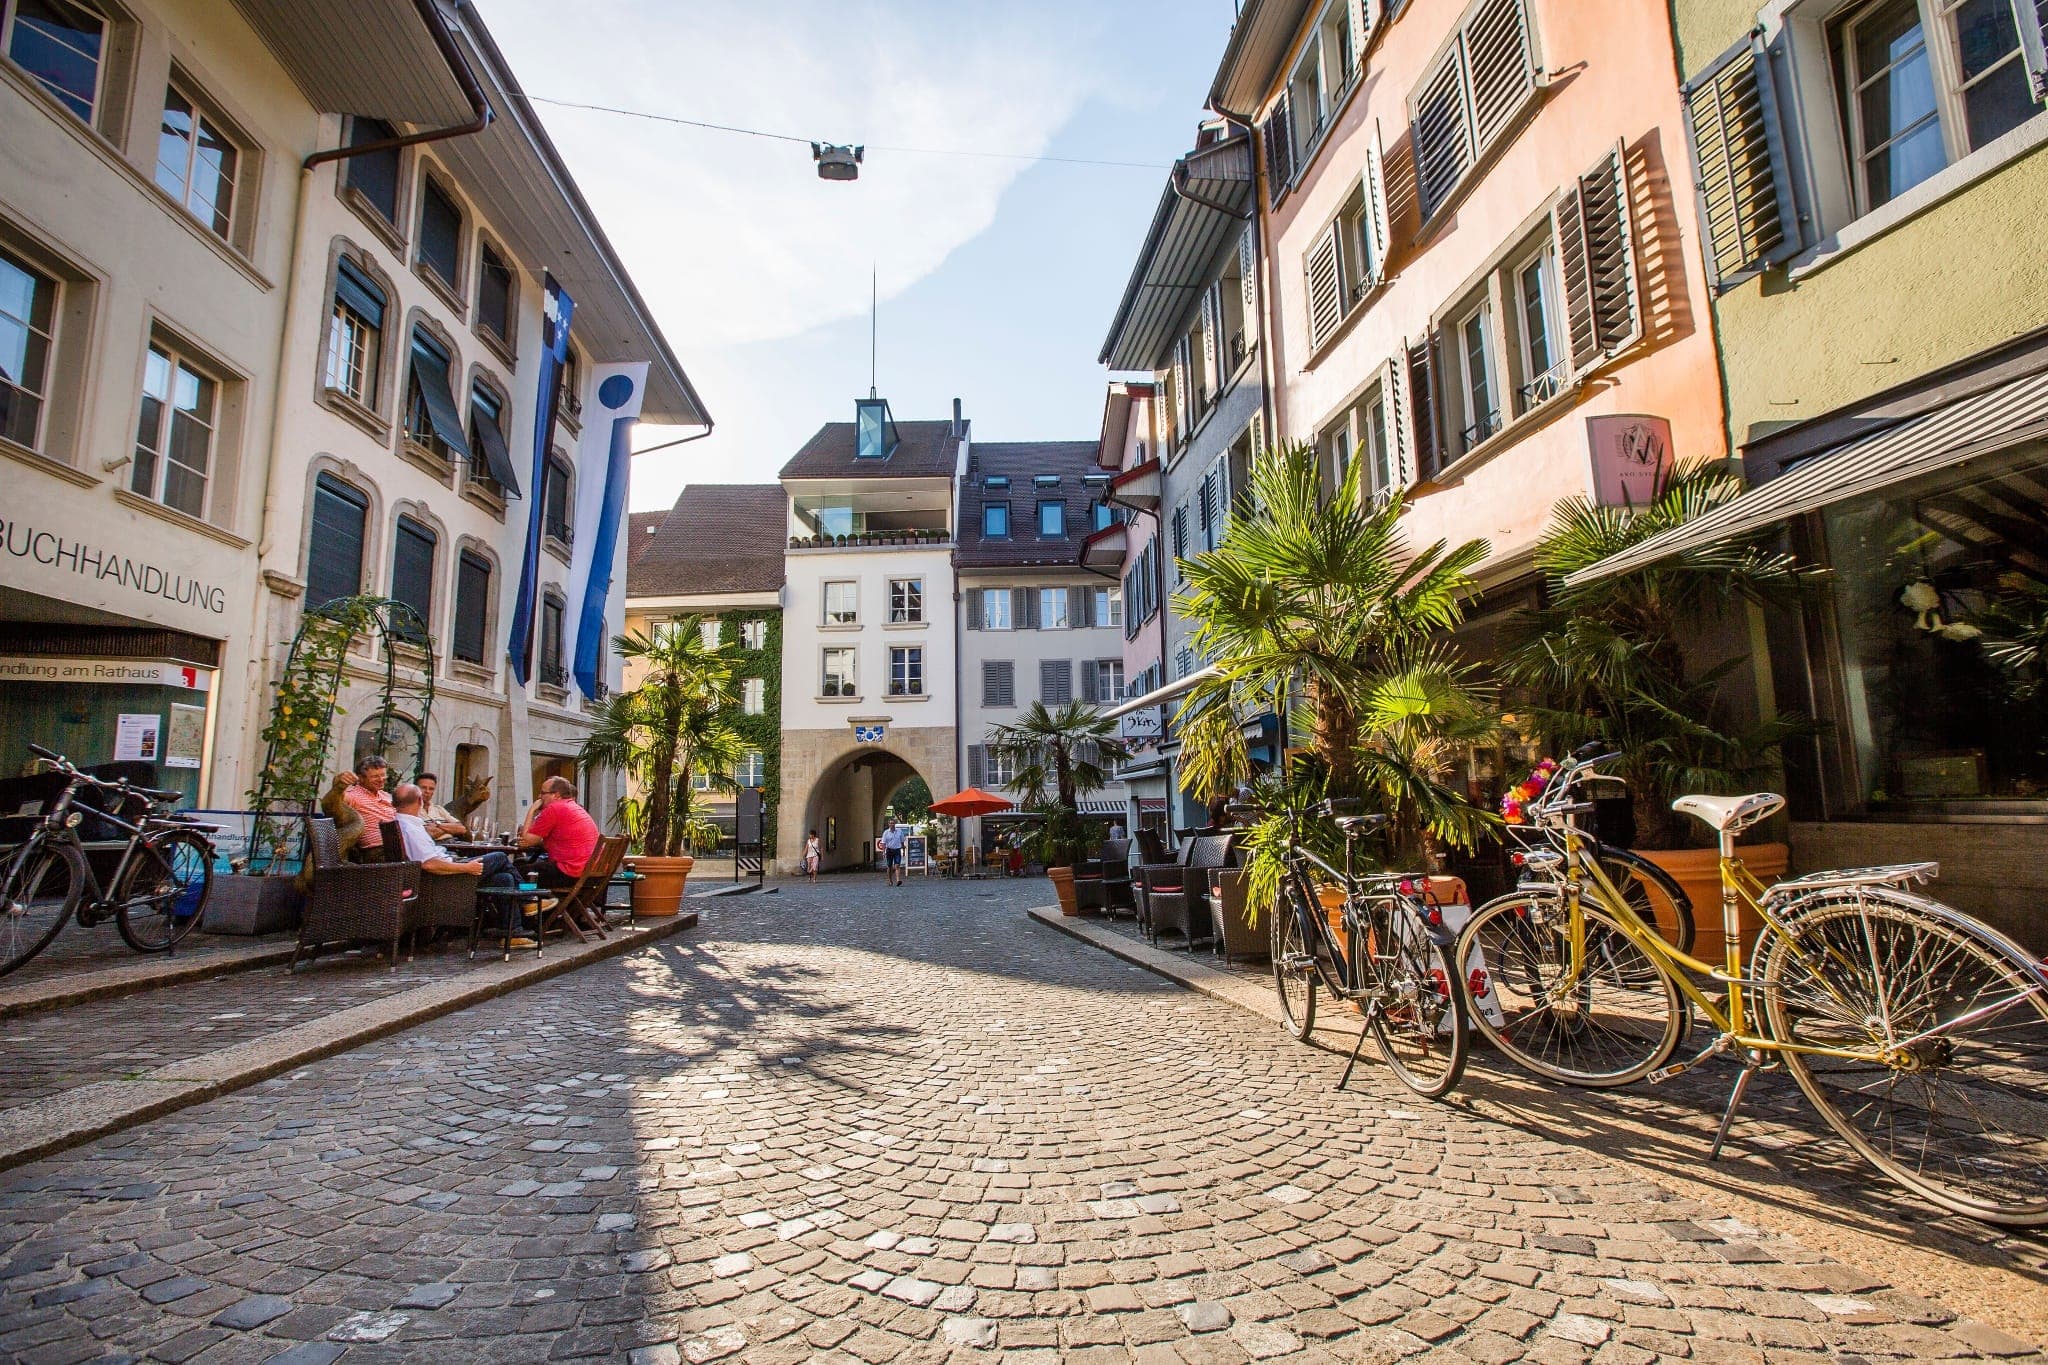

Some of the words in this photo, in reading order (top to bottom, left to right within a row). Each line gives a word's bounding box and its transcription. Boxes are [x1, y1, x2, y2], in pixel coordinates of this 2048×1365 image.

[0, 518, 225, 614] UCHHANDLUNG
[62, 666, 89, 676] am
[94, 664, 160, 679] Rathaus
